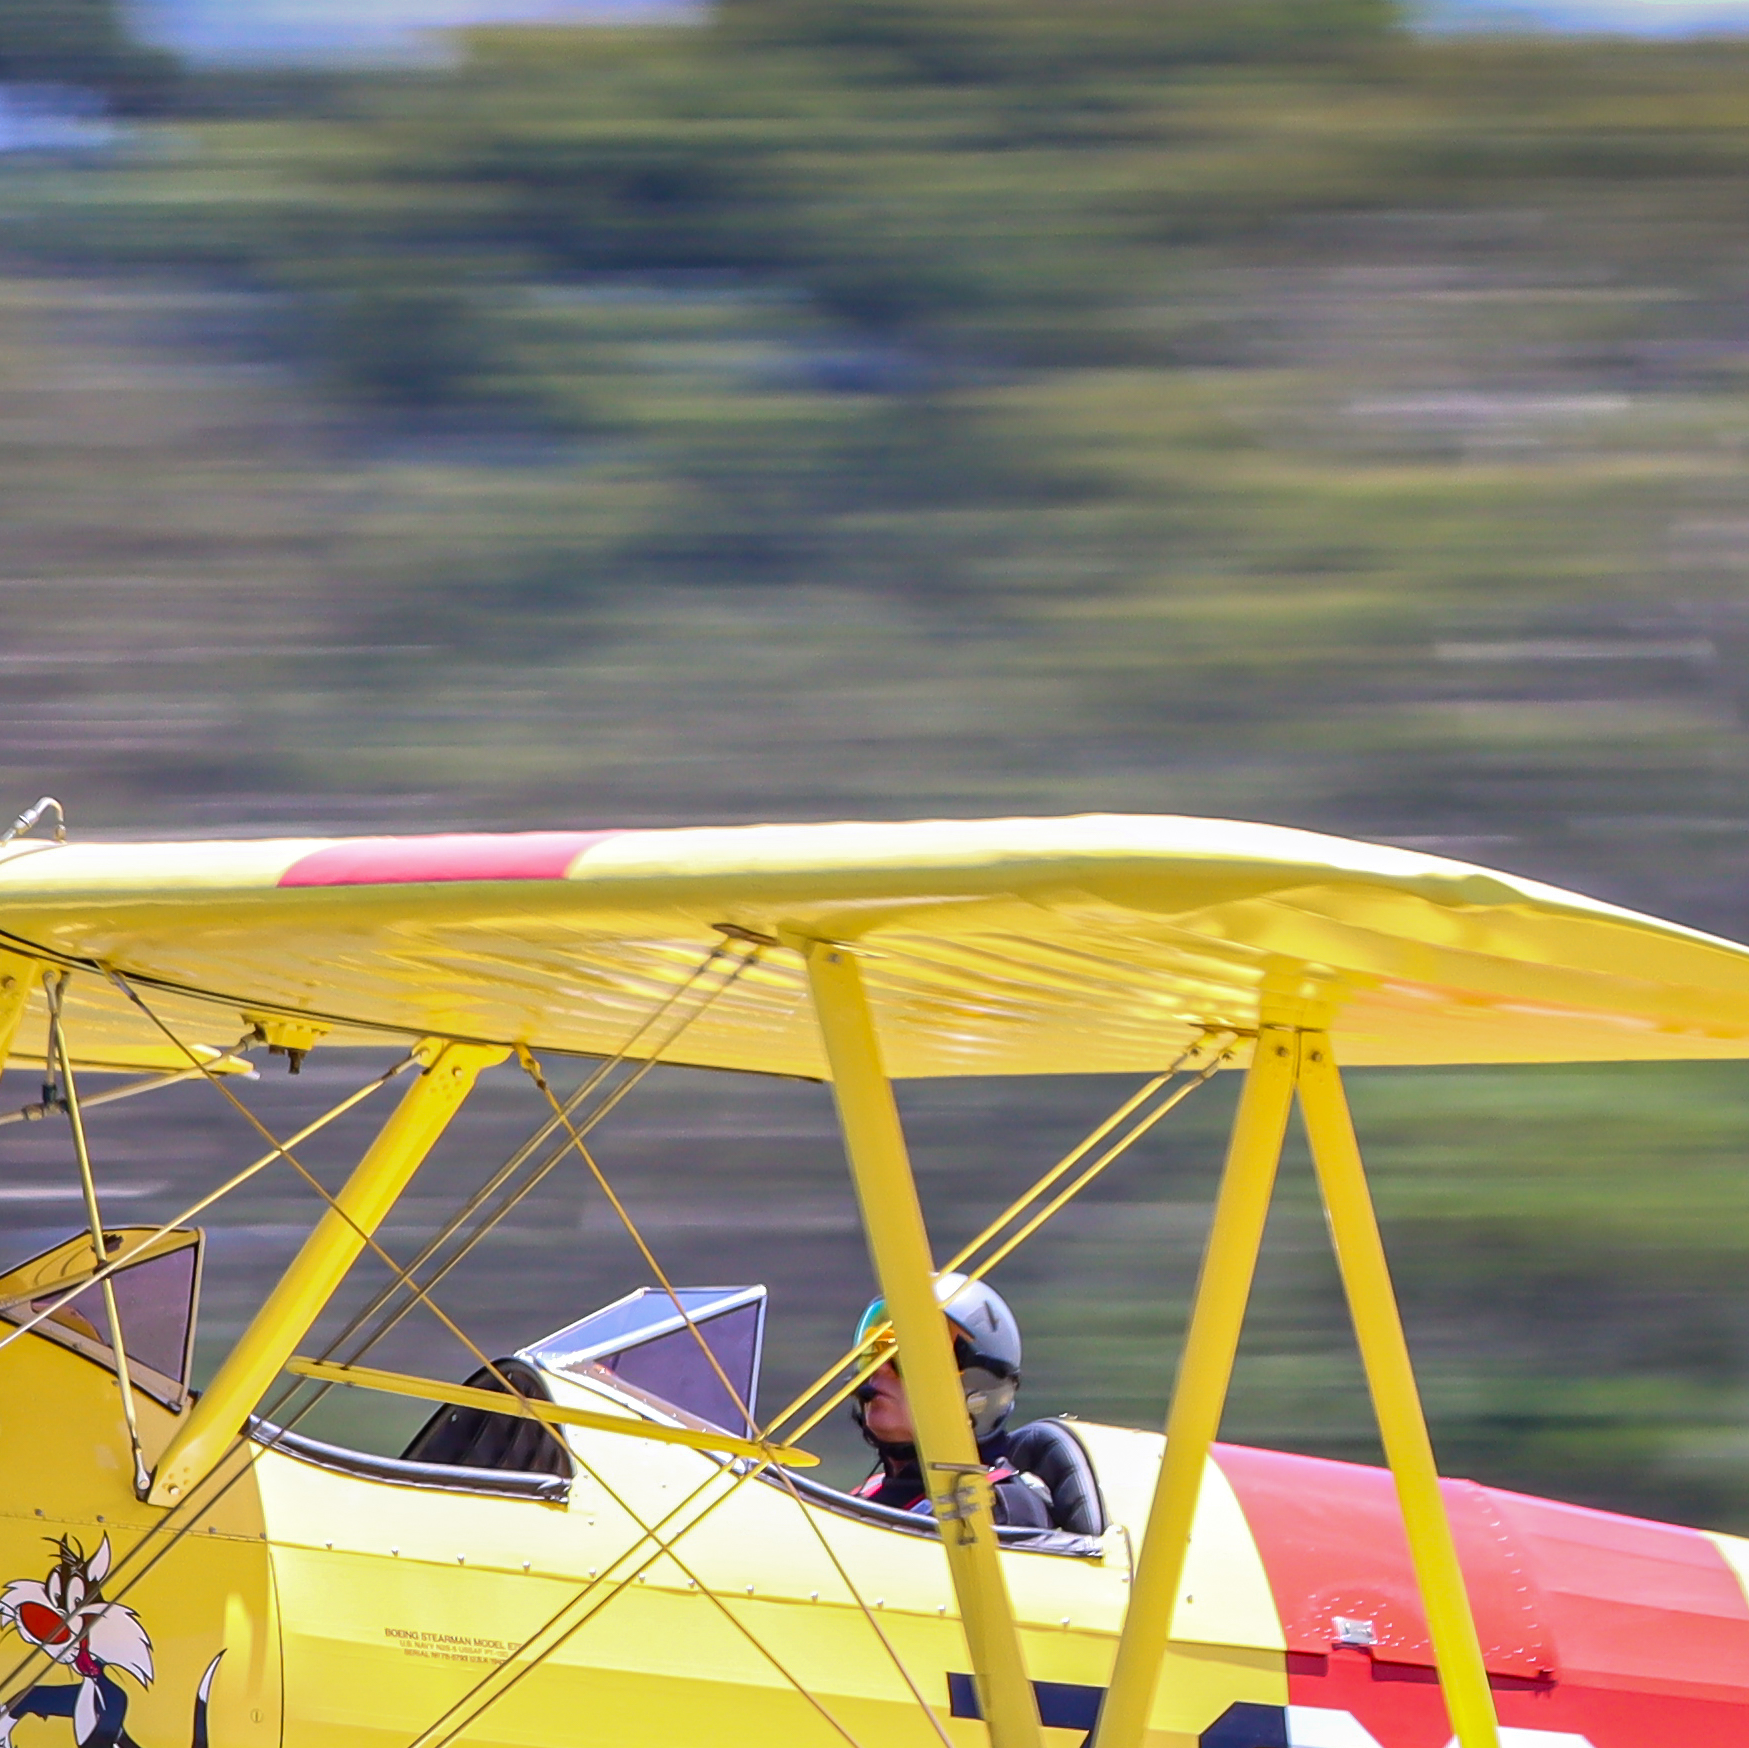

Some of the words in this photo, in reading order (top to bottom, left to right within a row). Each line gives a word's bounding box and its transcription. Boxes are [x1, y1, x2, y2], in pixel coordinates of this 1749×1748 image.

[384, 1627, 419, 1640] BOEING
[421, 1633, 472, 1646] STEARMAN
[473, 1638, 505, 1650] MODEL
